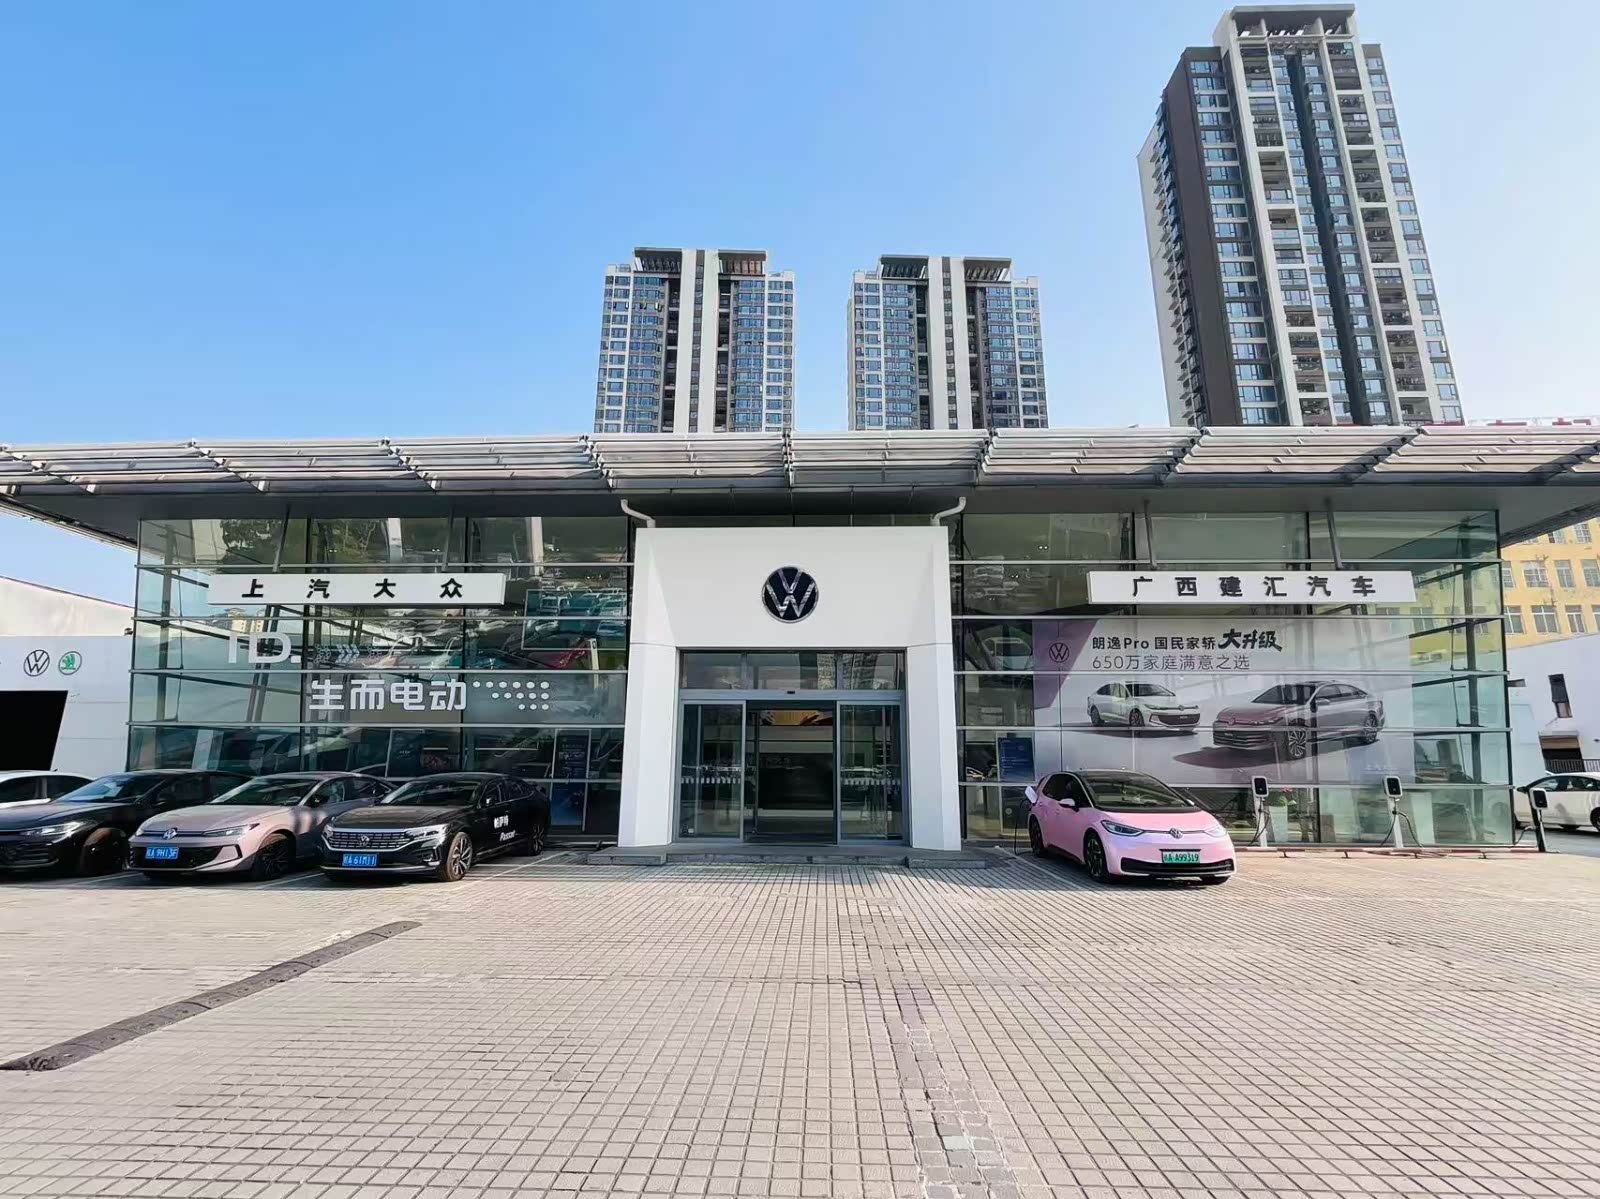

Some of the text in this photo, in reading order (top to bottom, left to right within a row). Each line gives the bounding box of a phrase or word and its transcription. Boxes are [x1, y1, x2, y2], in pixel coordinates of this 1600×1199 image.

[241, 577, 464, 599] 上汽大众
[1132, 576, 1376, 597] 广西建汇汽车
[228, 632, 302, 664] ID.
[1092, 655, 1250, 670] 650万家庭满意之选
[308, 679, 466, 711] 生而电动
